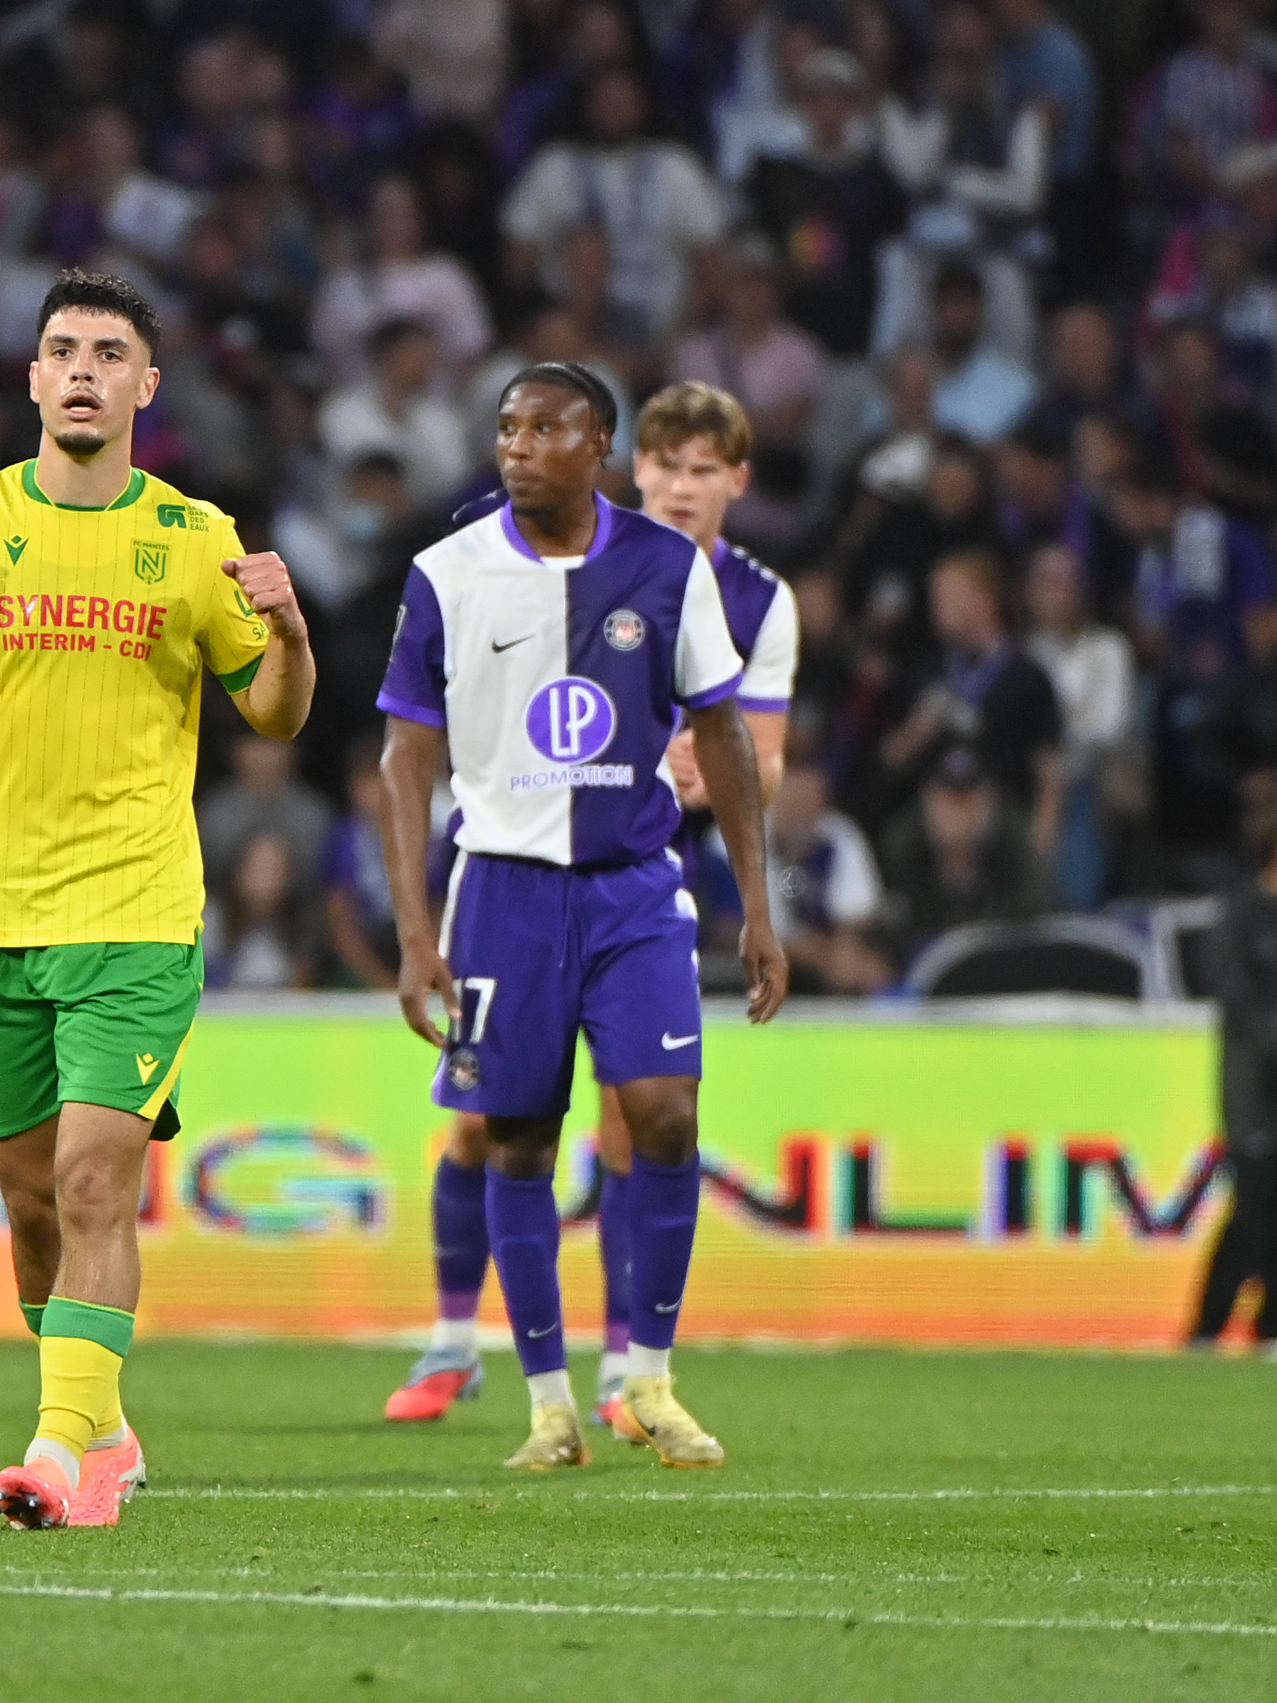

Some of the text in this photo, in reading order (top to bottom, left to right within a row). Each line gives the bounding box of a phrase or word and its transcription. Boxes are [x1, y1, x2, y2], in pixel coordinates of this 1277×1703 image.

[190, 523, 209, 532] EAUX
[142, 542, 169, 551] NANTES
[3, 633, 96, 652] INTERIM
[119, 640, 152, 661] CDI
[549, 685, 597, 757] LP
[510, 765, 634, 791] PROMOTION
